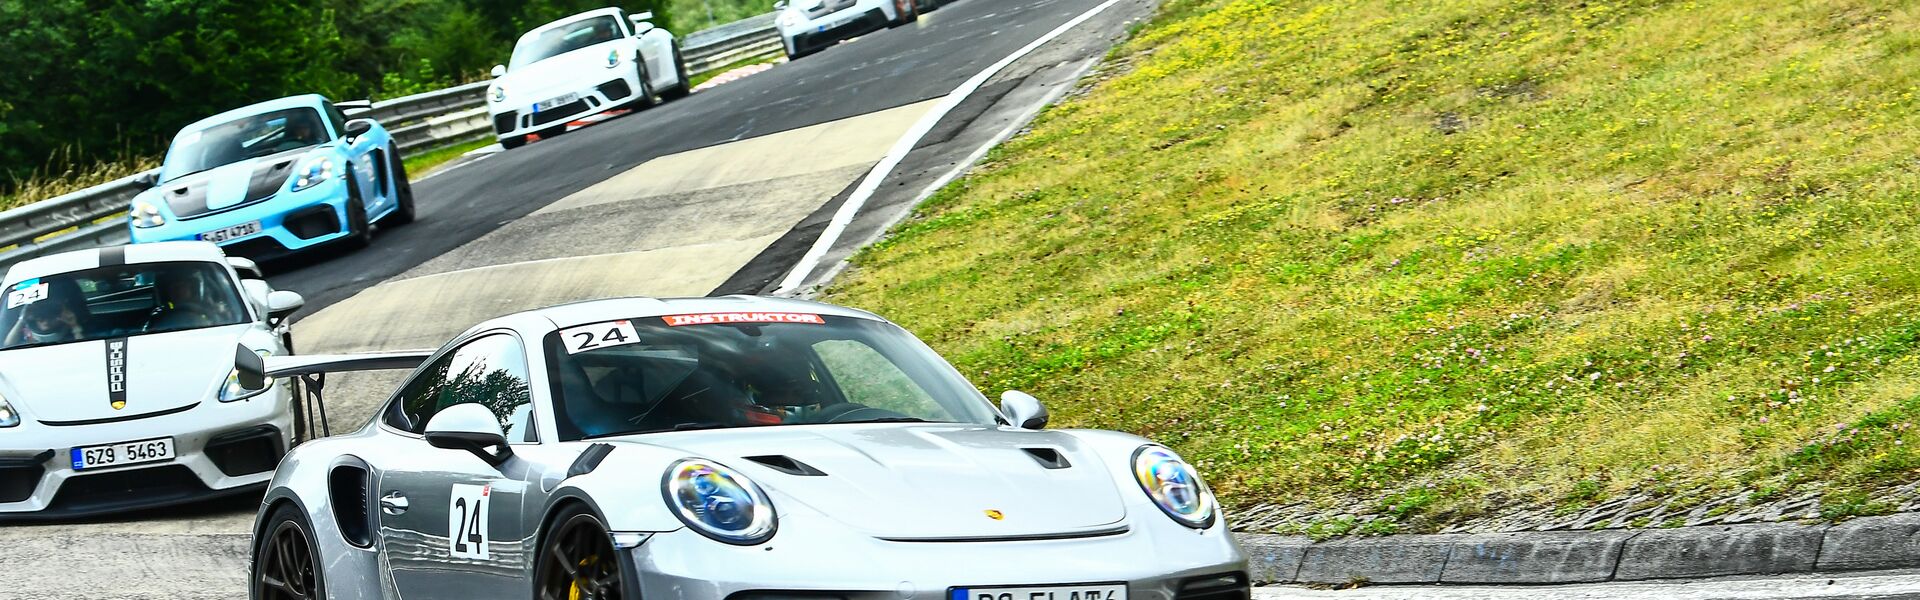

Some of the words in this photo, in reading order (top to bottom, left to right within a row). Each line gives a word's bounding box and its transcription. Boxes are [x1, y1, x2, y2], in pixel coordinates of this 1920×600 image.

[15, 289, 40, 305] 24
[671, 313, 818, 324] INSTRUKTOR
[572, 327, 629, 350] 24
[85, 447, 115, 465] 6Z9
[127, 441, 167, 460] 5463
[455, 496, 482, 554] 24
